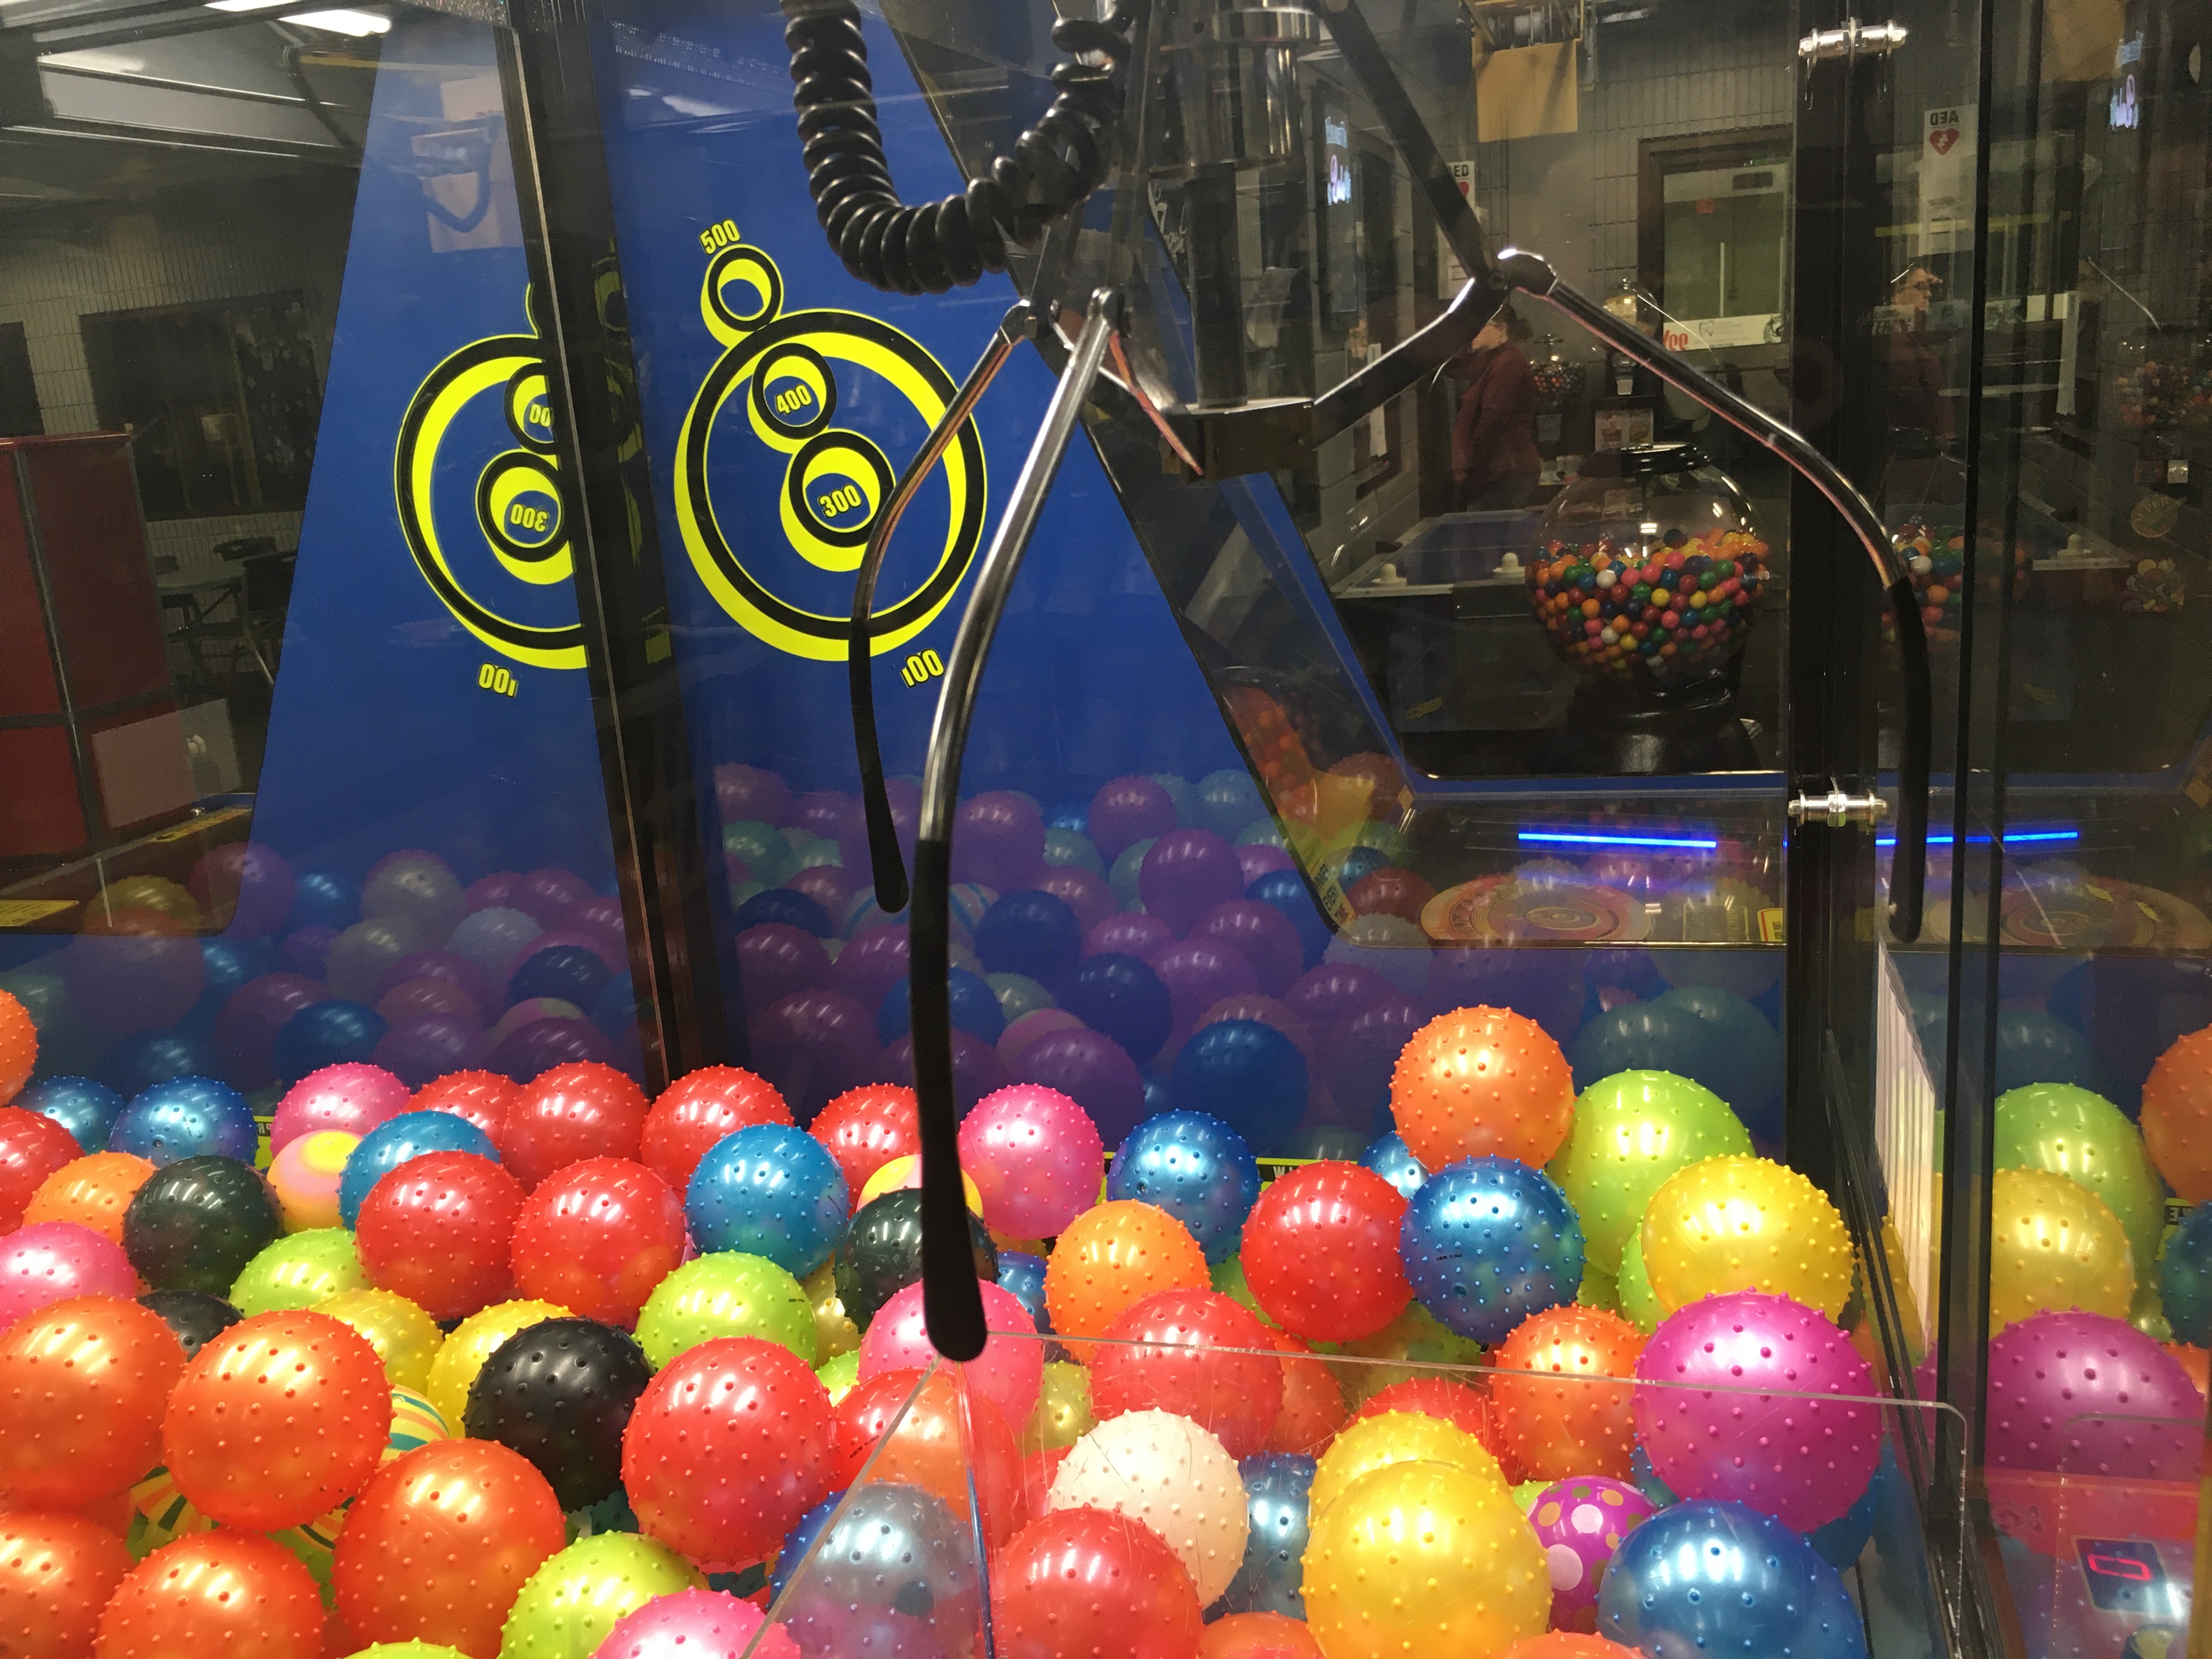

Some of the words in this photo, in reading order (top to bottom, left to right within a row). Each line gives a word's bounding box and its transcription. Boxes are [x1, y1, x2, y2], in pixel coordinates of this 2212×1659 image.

[699, 219, 740, 255] 500
[776, 385, 812, 414] 400
[819, 484, 861, 517] 300
[901, 649, 944, 687] 100
[1322, 882, 1339, 911] EVERY
